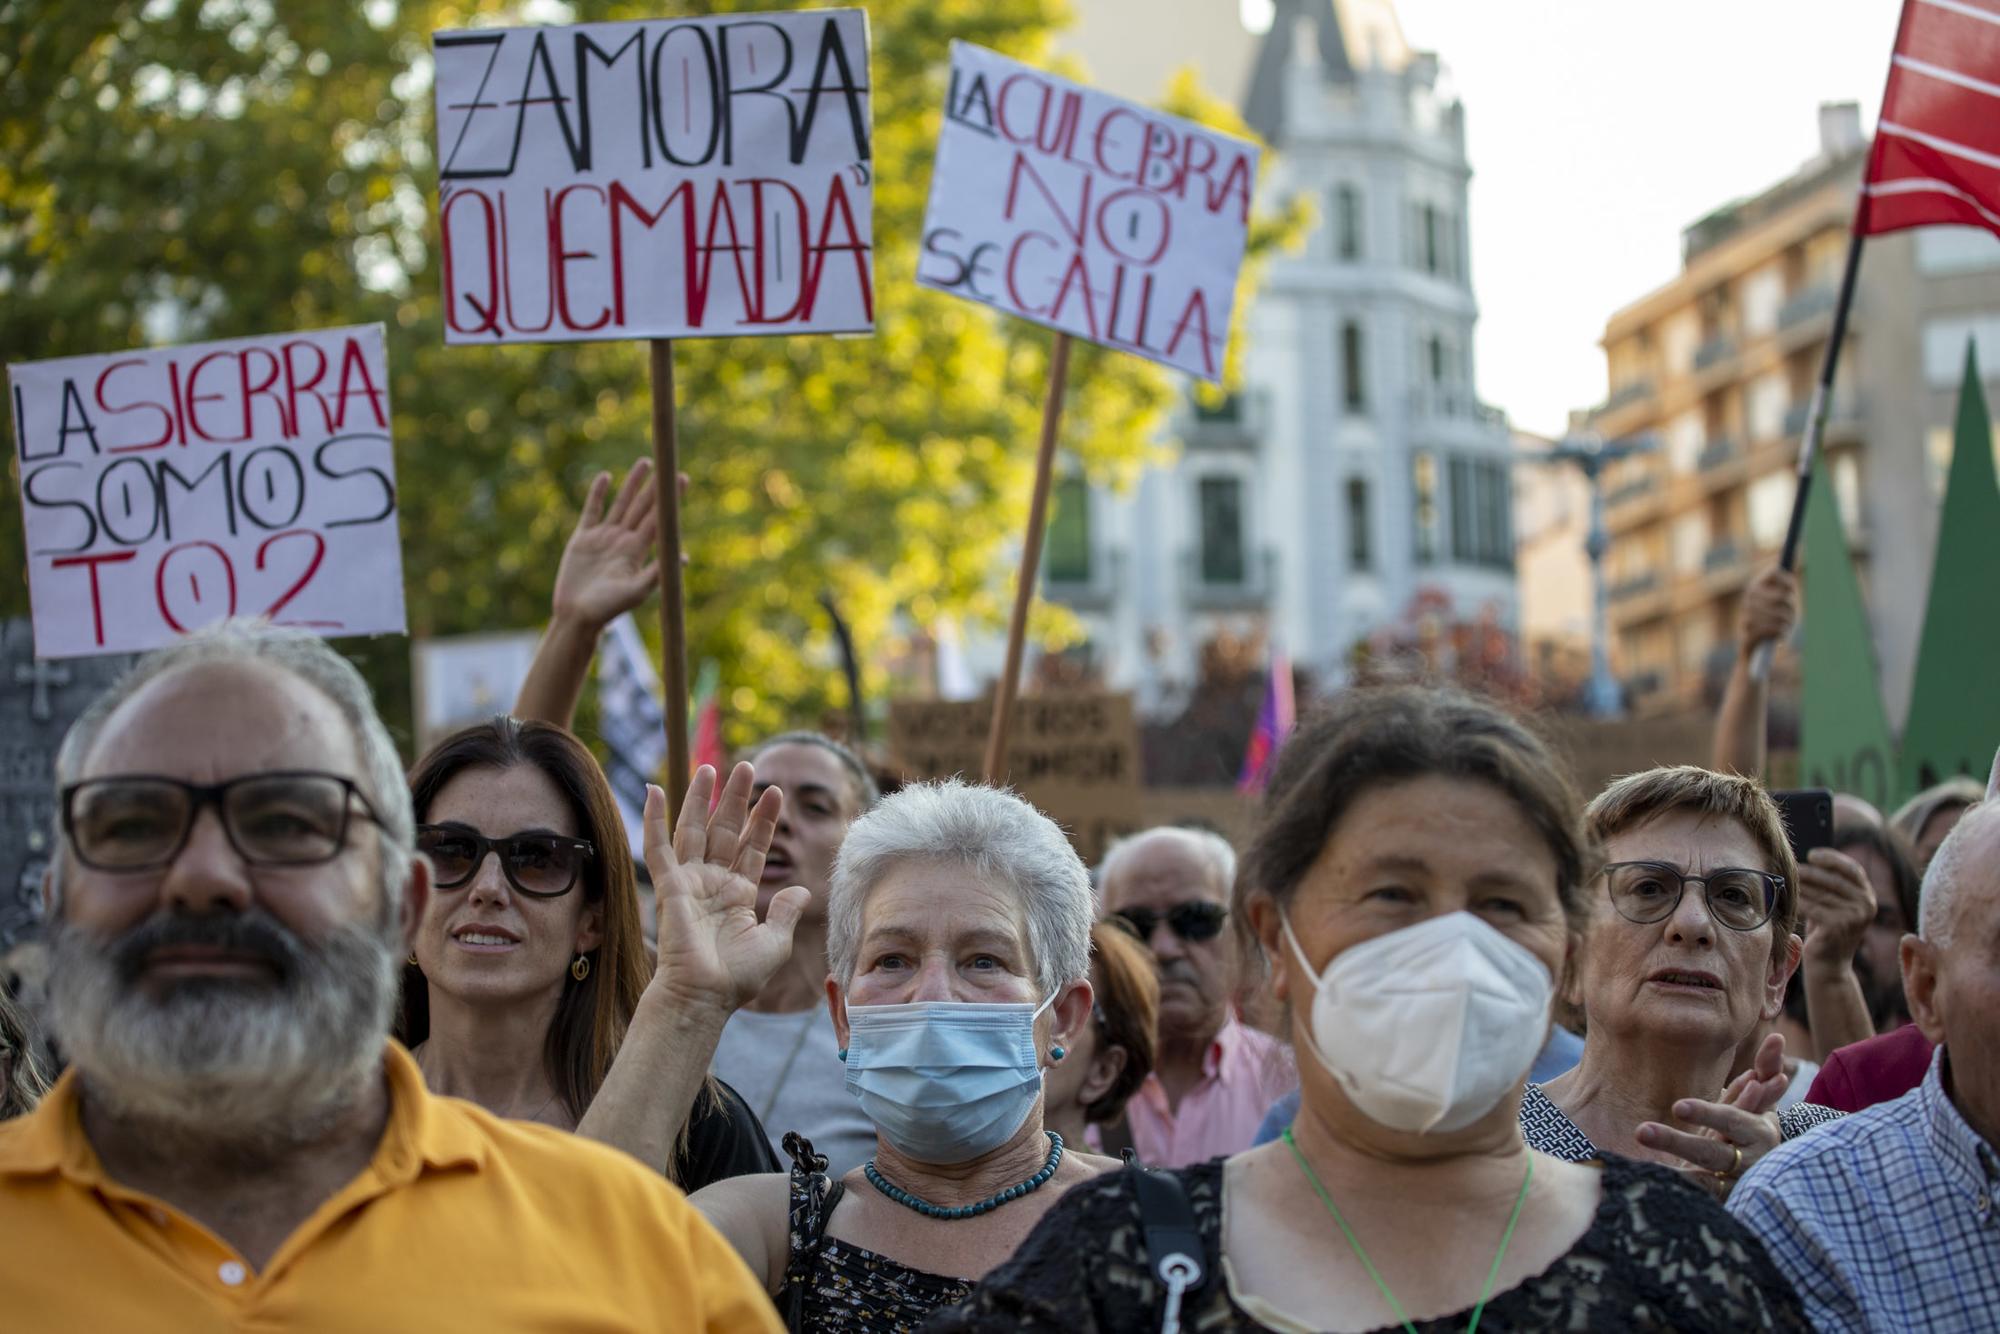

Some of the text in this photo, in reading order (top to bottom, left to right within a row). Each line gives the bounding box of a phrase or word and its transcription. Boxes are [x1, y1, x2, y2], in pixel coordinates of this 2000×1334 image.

[433, 17, 871, 180] ZAMORA
[946, 67, 1250, 226] LA CULEBRA
[1002, 150, 1172, 267] NO
[924, 227, 1223, 375] SE CALLA
[14, 337, 389, 462] LA SIERRA
[23, 433, 398, 556] SOMOS
